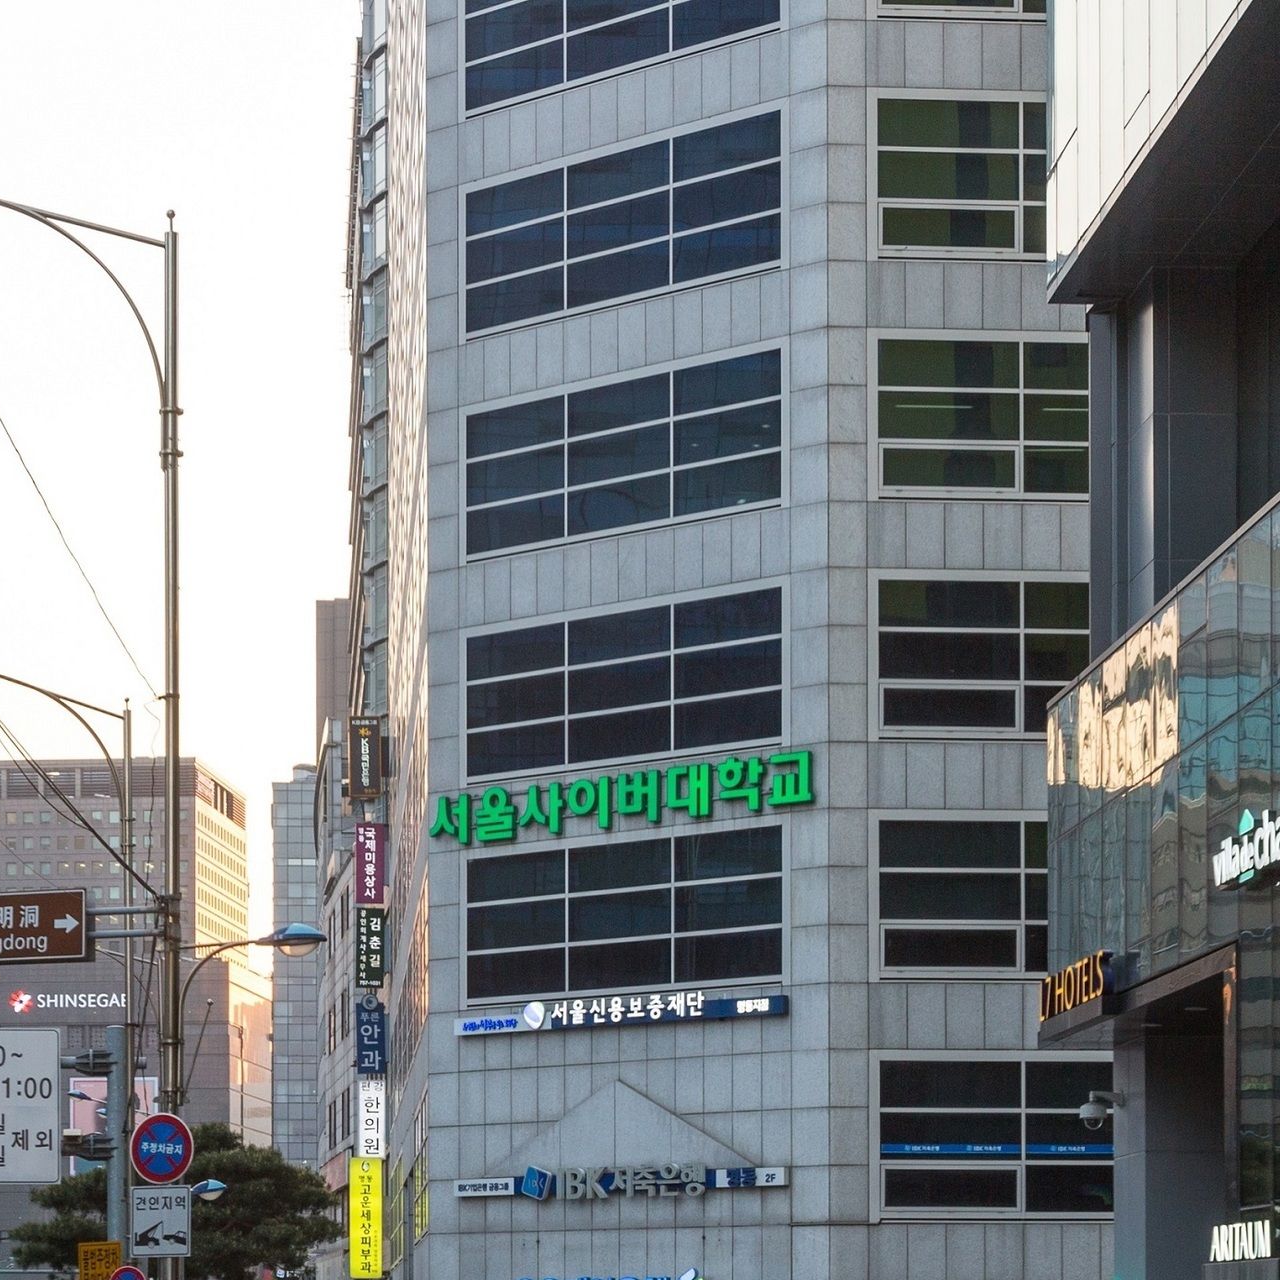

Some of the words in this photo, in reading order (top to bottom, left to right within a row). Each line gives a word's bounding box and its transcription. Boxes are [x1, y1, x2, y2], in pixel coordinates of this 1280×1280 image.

[429, 749, 813, 845] 서울사이버대학교
[364, 828, 376, 899] 국제미용상사
[1212, 836, 1240, 887] villa
[1240, 834, 1255, 872] de
[369, 918, 381, 967] 김춘길
[1056, 949, 1104, 1015] HOTELS
[360, 1012, 380, 1022] 푸른
[552, 991, 705, 1026] 서울신용보증재단
[361, 1025, 381, 1070] 안과
[11, 1129, 54, 1151] 제외
[141, 1142, 183, 1155] 주정차금지
[364, 1097, 380, 1155] 한의원
[726, 1168, 757, 1188] 명동
[764, 1173, 776, 1184] 2F
[135, 1196, 186, 1211] 견인지역
[360, 1184, 372, 1273] 고운세상피부과
[1209, 1220, 1272, 1262] ARITAUM
